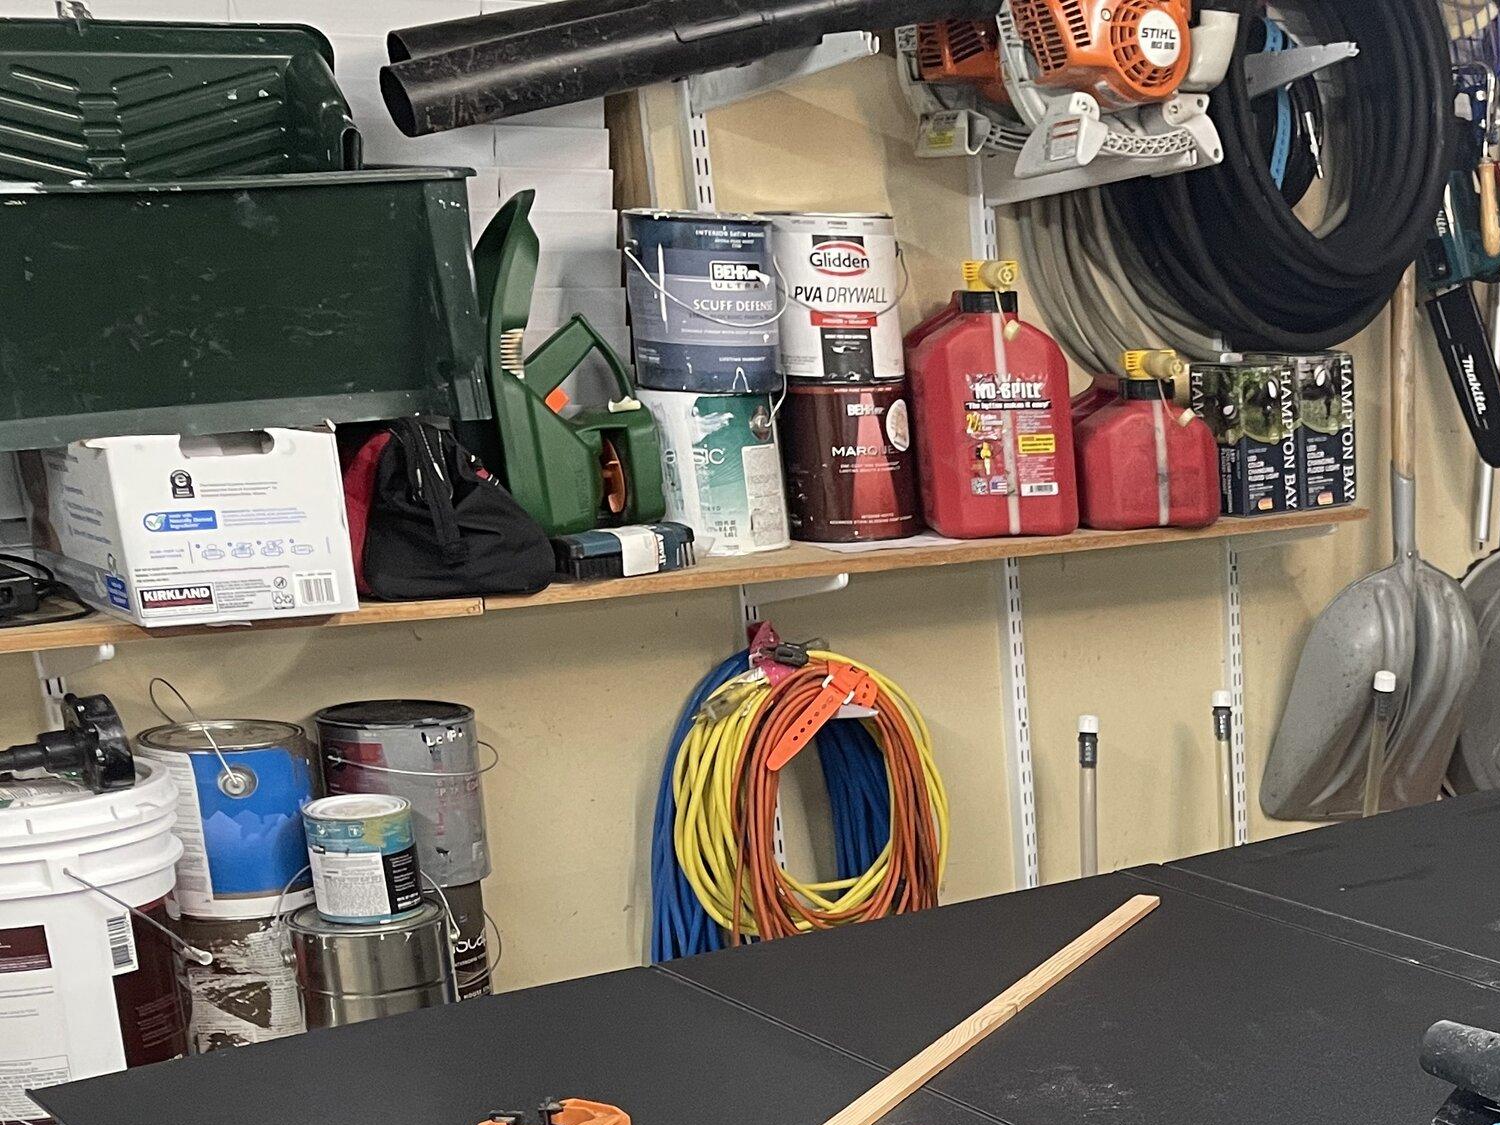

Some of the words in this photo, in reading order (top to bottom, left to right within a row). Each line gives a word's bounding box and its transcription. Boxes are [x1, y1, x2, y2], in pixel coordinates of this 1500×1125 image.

[1141, 27, 1176, 40] STIHL
[809, 252, 870, 269] Glidden
[713, 264, 750, 280] BEHR
[794, 286, 823, 303] PVA
[826, 286, 888, 304] DRYWALL
[693, 299, 732, 311] SCUFF
[735, 300, 773, 312] DEFENSE
[1461, 353, 1487, 415] makita
[846, 403, 876, 417] BEHR
[1340, 357, 1355, 461] HAMPTON
[1280, 370, 1296, 470] HAMPTON
[1284, 473, 1298, 509] BAY
[1342, 465, 1356, 500] BAY
[142, 586, 210, 602] KIRKLAND
